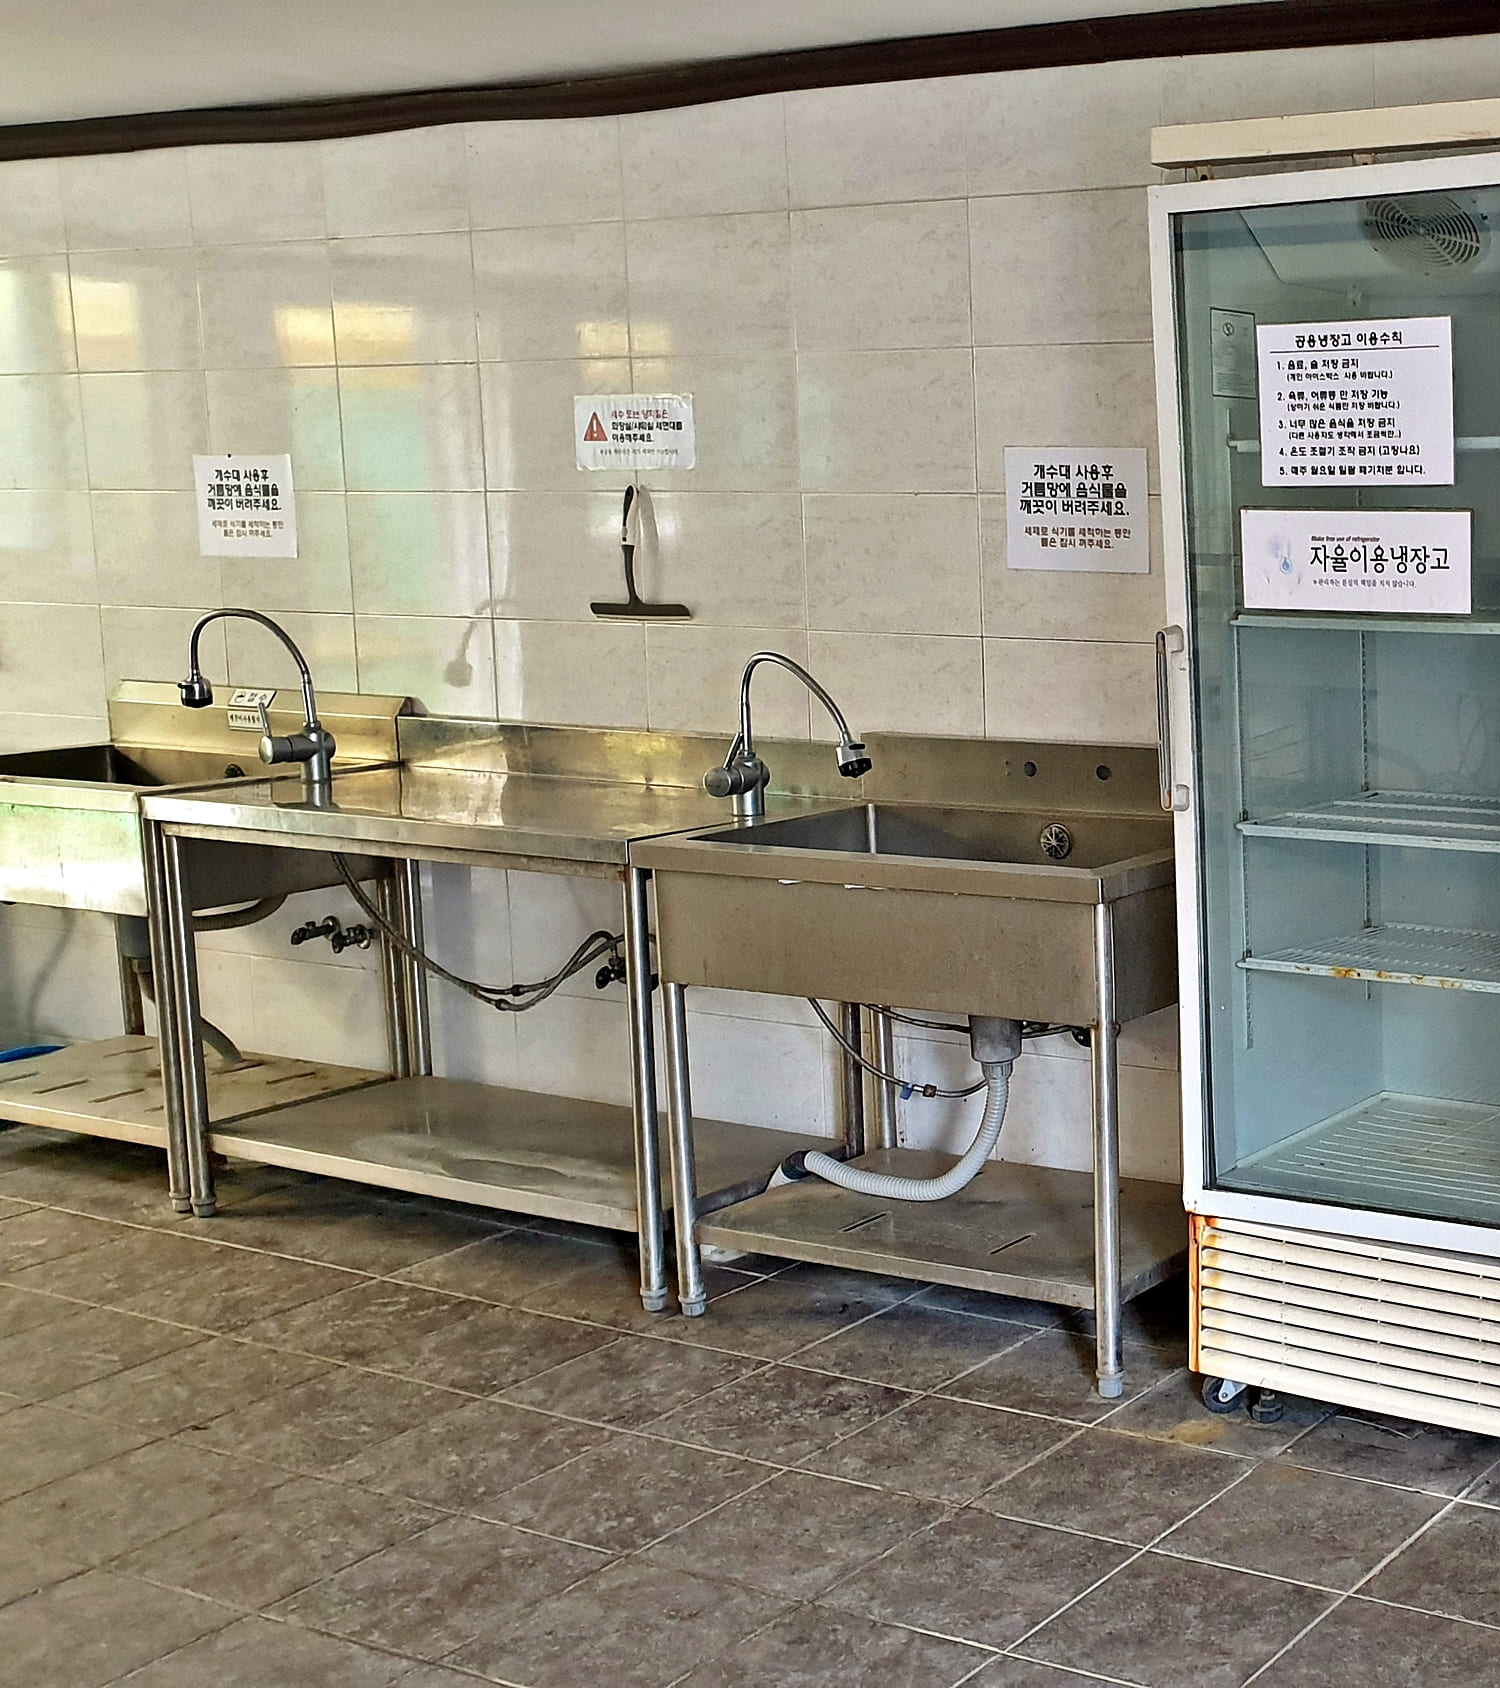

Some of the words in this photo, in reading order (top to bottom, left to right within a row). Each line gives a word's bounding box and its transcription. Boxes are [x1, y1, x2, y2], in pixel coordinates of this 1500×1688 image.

[1295, 334, 1351, 348] 공용냉장고
[1357, 331, 1402, 345] 이용수칙
[1277, 361, 1285, 370] 1.
[1288, 360, 1307, 370] 음료,
[1322, 359, 1338, 369] 저장
[1342, 359, 1359, 368] 금지
[1305, 372, 1339, 380] 아이스박스
[1345, 371, 1357, 379] 사용
[1277, 392, 1285, 401] 2.
[1289, 391, 1308, 401] 육류,
[1311, 390, 1336, 400] 어류등
[1340, 390, 1348, 400] 만
[1351, 390, 1368, 399] 저장
[1329, 402, 1348, 410] 식품만
[1352, 402, 1365, 410] 저장
[627, 410, 639, 419] 또는
[612, 422, 653, 431] 화장실/샤워실
[656, 422, 682, 431] 세면대를
[1278, 420, 1286, 429] 3.
[1290, 419, 1305, 428] 너무
[1309, 419, 1326, 428] 많은
[1358, 418, 1374, 427] 저장
[1378, 417, 1395, 427] 금지
[1289, 431, 1304, 439] (다른
[1307, 431, 1334, 439] 사용자도
[1337, 430, 1364, 438] 생각해서
[1279, 447, 1287, 456] 4.
[1290, 446, 1307, 456] 온도
[1310, 446, 1335, 456] 조절기
[1338, 445, 1355, 456] 조작
[1359, 445, 1375, 456] 금지
[1379, 445, 1419, 456] (고장나요)
[215, 469, 240, 481] 개수대
[244, 469, 269, 482] 사용후
[1034, 464, 1070, 480] 개수대
[1076, 464, 1114, 480] 사용후
[1279, 467, 1287, 475] 5.
[1291, 466, 1307, 476] 매주
[1311, 466, 1335, 475] 월요일
[1339, 465, 1355, 475] 일괄
[1359, 465, 1393, 475] 폐기처분
[1397, 465, 1425, 475] 합니다.
[208, 484, 241, 496] 거름망에
[245, 484, 279, 496] 음식물을
[1022, 482, 1071, 498] 거름망에
[1076, 483, 1127, 498] 음식물을
[208, 499, 233, 510] 깨끗이
[236, 499, 282, 511] 버려주세요.
[1020, 500, 1057, 515] 깨끗이
[1062, 501, 1129, 516] 버려주세요.
[1025, 527, 1048, 536] 세제로
[1052, 527, 1075, 536] 식기를
[1079, 527, 1111, 537] 세척하는
[1115, 528, 1131, 538] 동안
[1041, 538, 1056, 547] 물은
[1060, 538, 1076, 547] 잠시
[1079, 539, 1114, 548] 꺼주세요.
[1310, 544, 1450, 574] 자율이용냉장고
